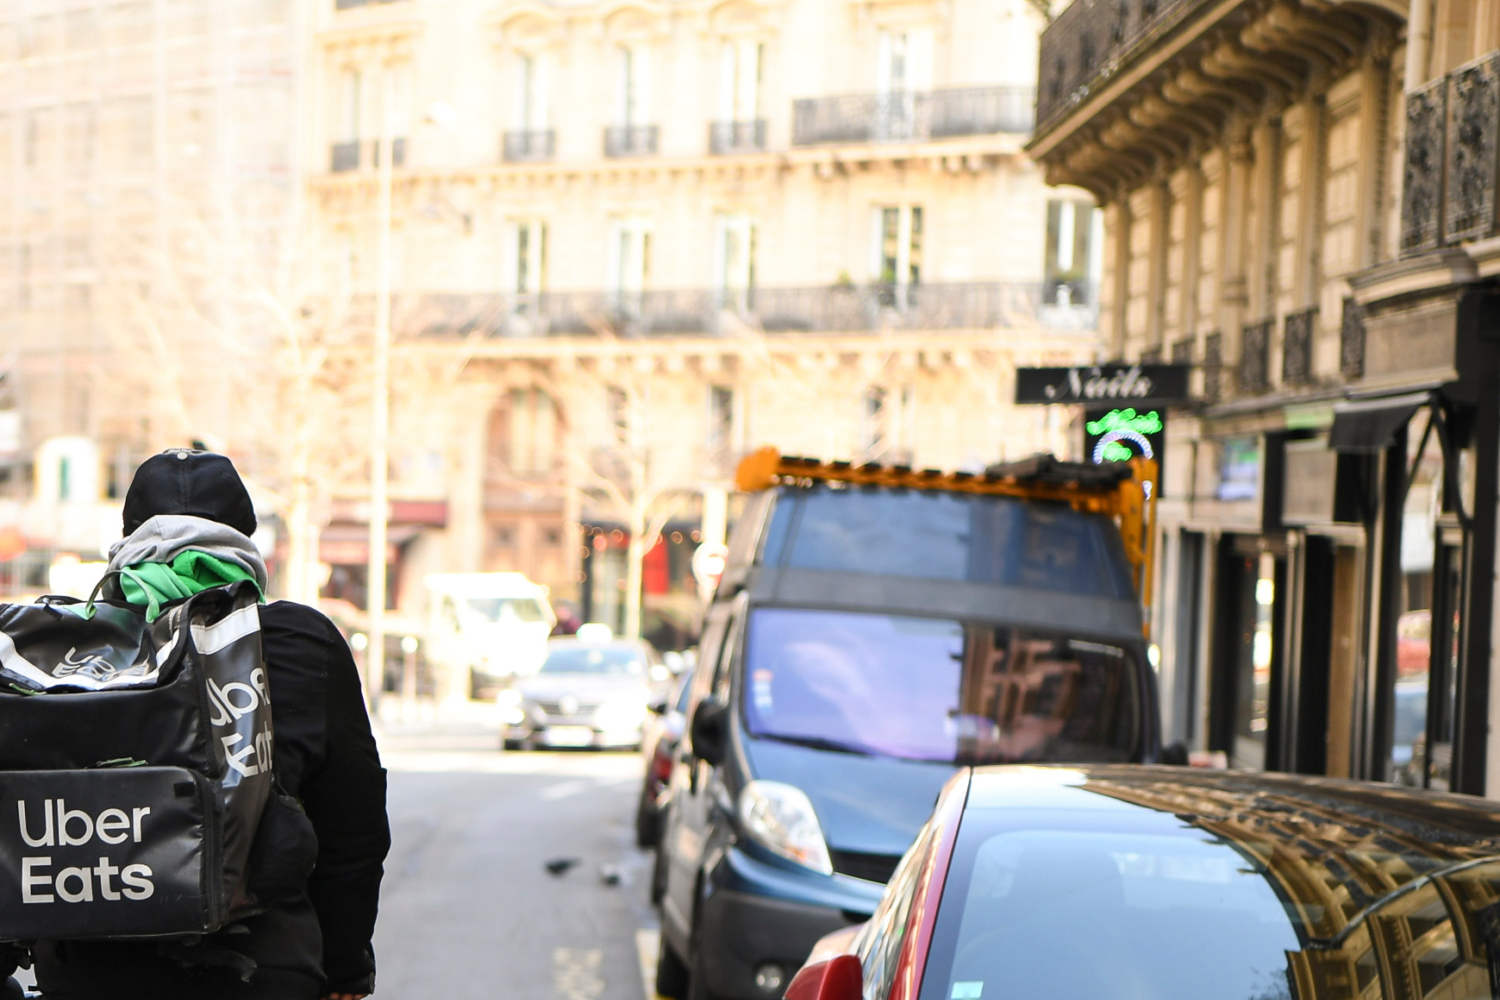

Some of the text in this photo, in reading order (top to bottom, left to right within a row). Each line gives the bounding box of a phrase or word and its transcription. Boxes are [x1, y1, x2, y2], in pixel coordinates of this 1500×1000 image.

[1044, 366, 1157, 399] Nails
[64, 646, 117, 673] Ub
[205, 667, 270, 726] Ube
[221, 720, 273, 778] Eat
[17, 798, 151, 848] Uber
[21, 856, 155, 904] Eats
